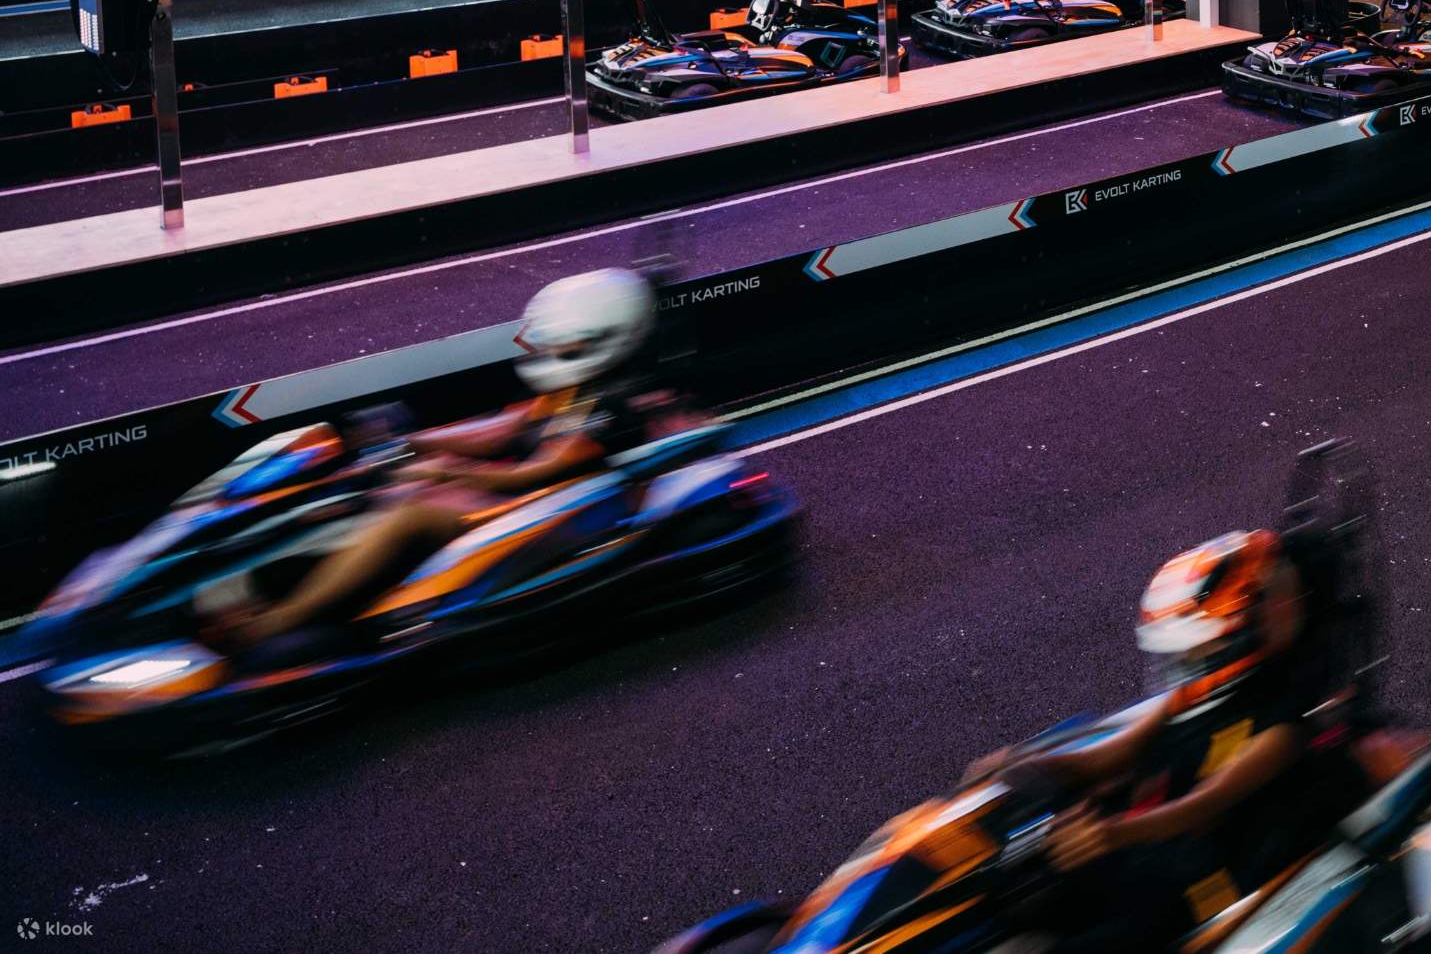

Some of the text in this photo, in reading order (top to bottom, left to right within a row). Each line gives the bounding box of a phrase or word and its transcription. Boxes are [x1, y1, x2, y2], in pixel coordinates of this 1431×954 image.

[1095, 183, 1131, 201] EVOLT
[1133, 169, 1182, 192] KARTING
[692, 276, 761, 303] KARTING
[45, 424, 149, 465] KARTING
